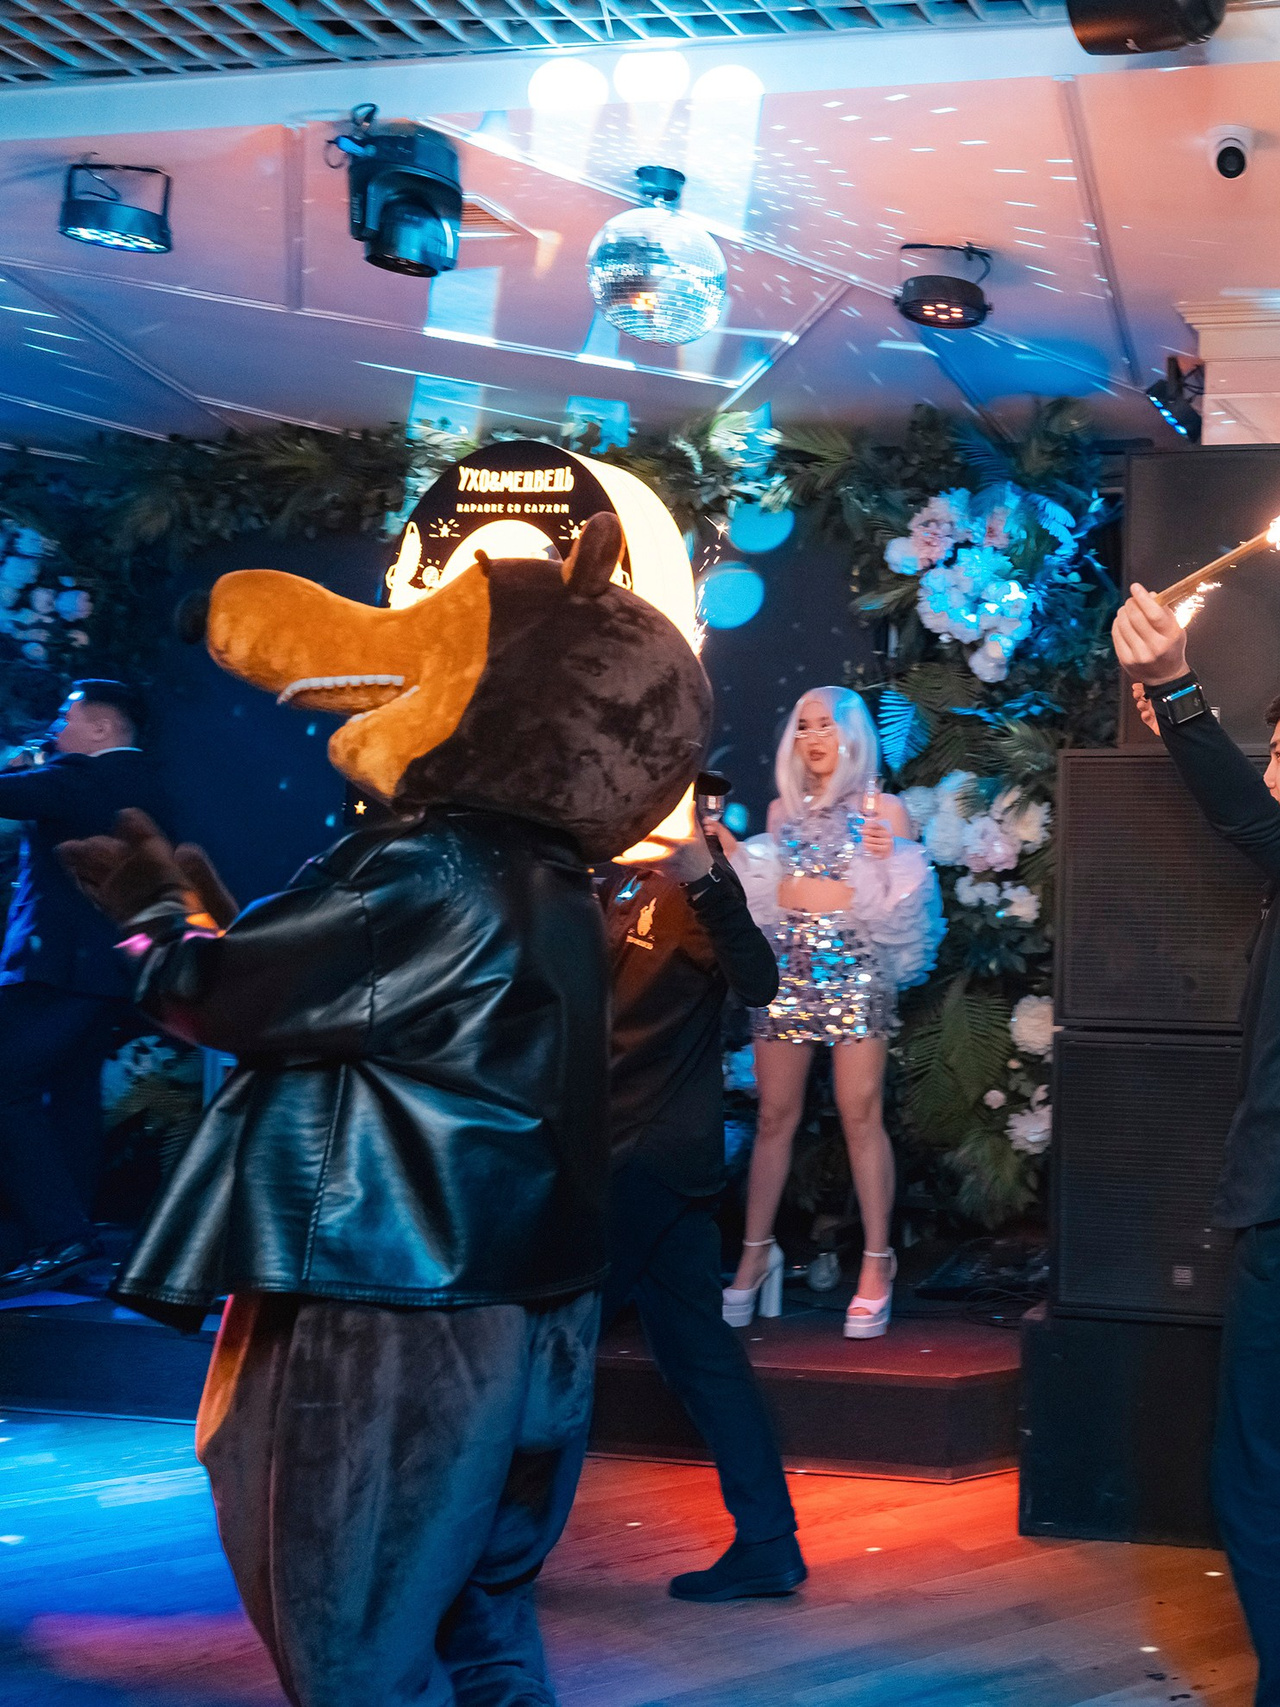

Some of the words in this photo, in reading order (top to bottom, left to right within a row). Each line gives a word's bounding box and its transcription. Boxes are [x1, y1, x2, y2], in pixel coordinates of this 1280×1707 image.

[457, 465, 575, 493] УХО&МЕДВЕДЬ
[456, 503, 504, 514] КАРАОКЕ
[506, 503, 522, 514] СО
